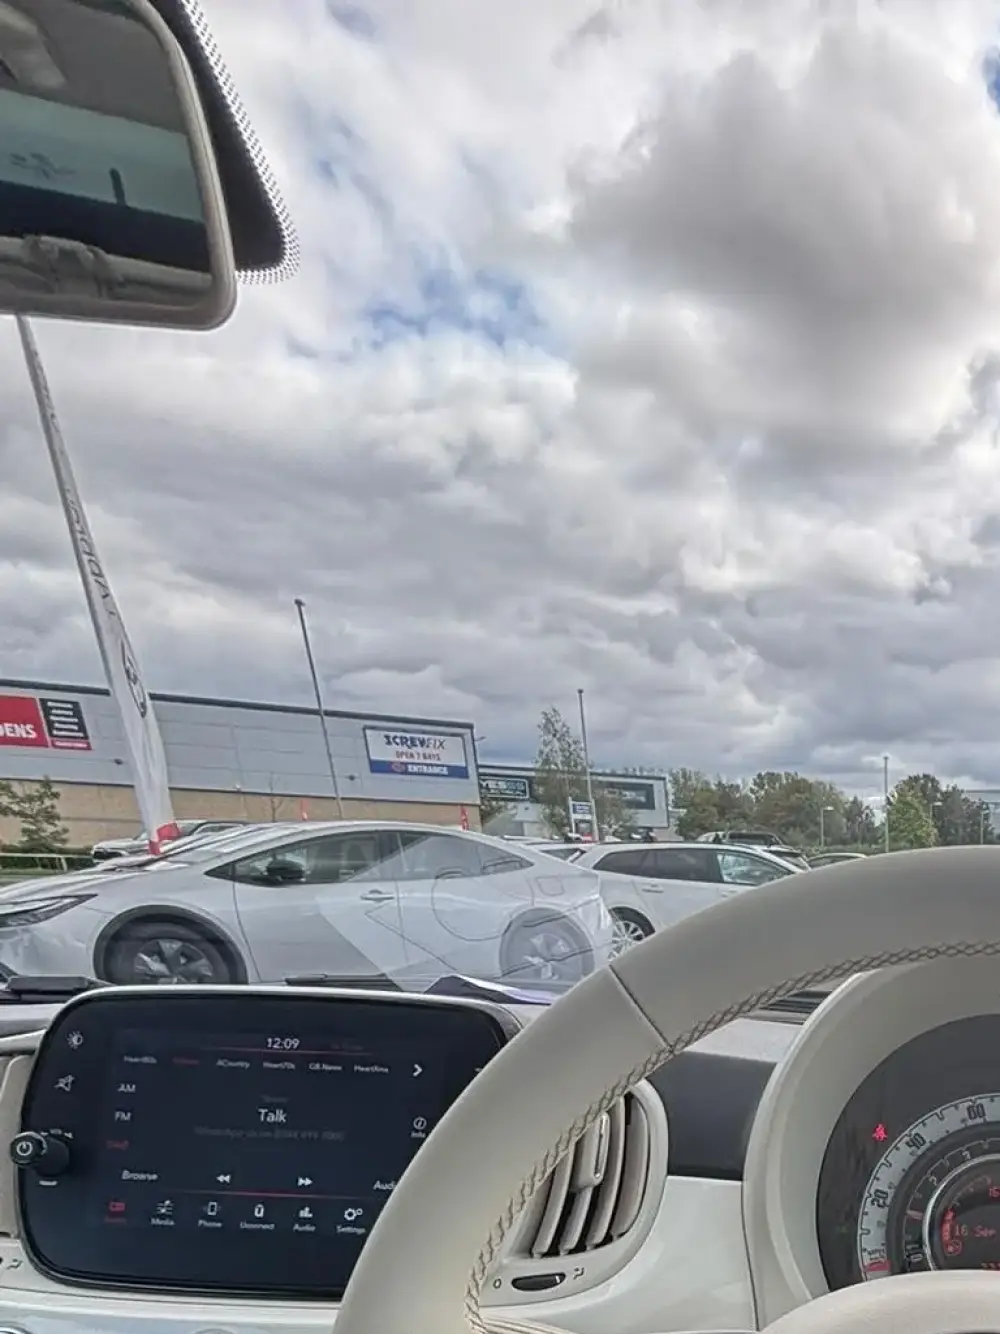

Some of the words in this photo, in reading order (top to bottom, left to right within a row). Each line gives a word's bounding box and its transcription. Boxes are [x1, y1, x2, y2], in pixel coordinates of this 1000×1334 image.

[266, 1037, 300, 1050] 12:09
[117, 1083, 137, 1093] AM
[114, 1110, 132, 1122] FM
[258, 1108, 287, 1123] Talk
[904, 1131, 927, 1151] 40
[121, 1169, 158, 1181] Browse
[372, 1179, 398, 1192] Aud
[870, 1188, 890, 1209] 20
[150, 1217, 175, 1227] Media
[197, 1219, 223, 1229] Phone
[293, 1223, 316, 1232] Audio
[336, 1224, 367, 1236] Settings
